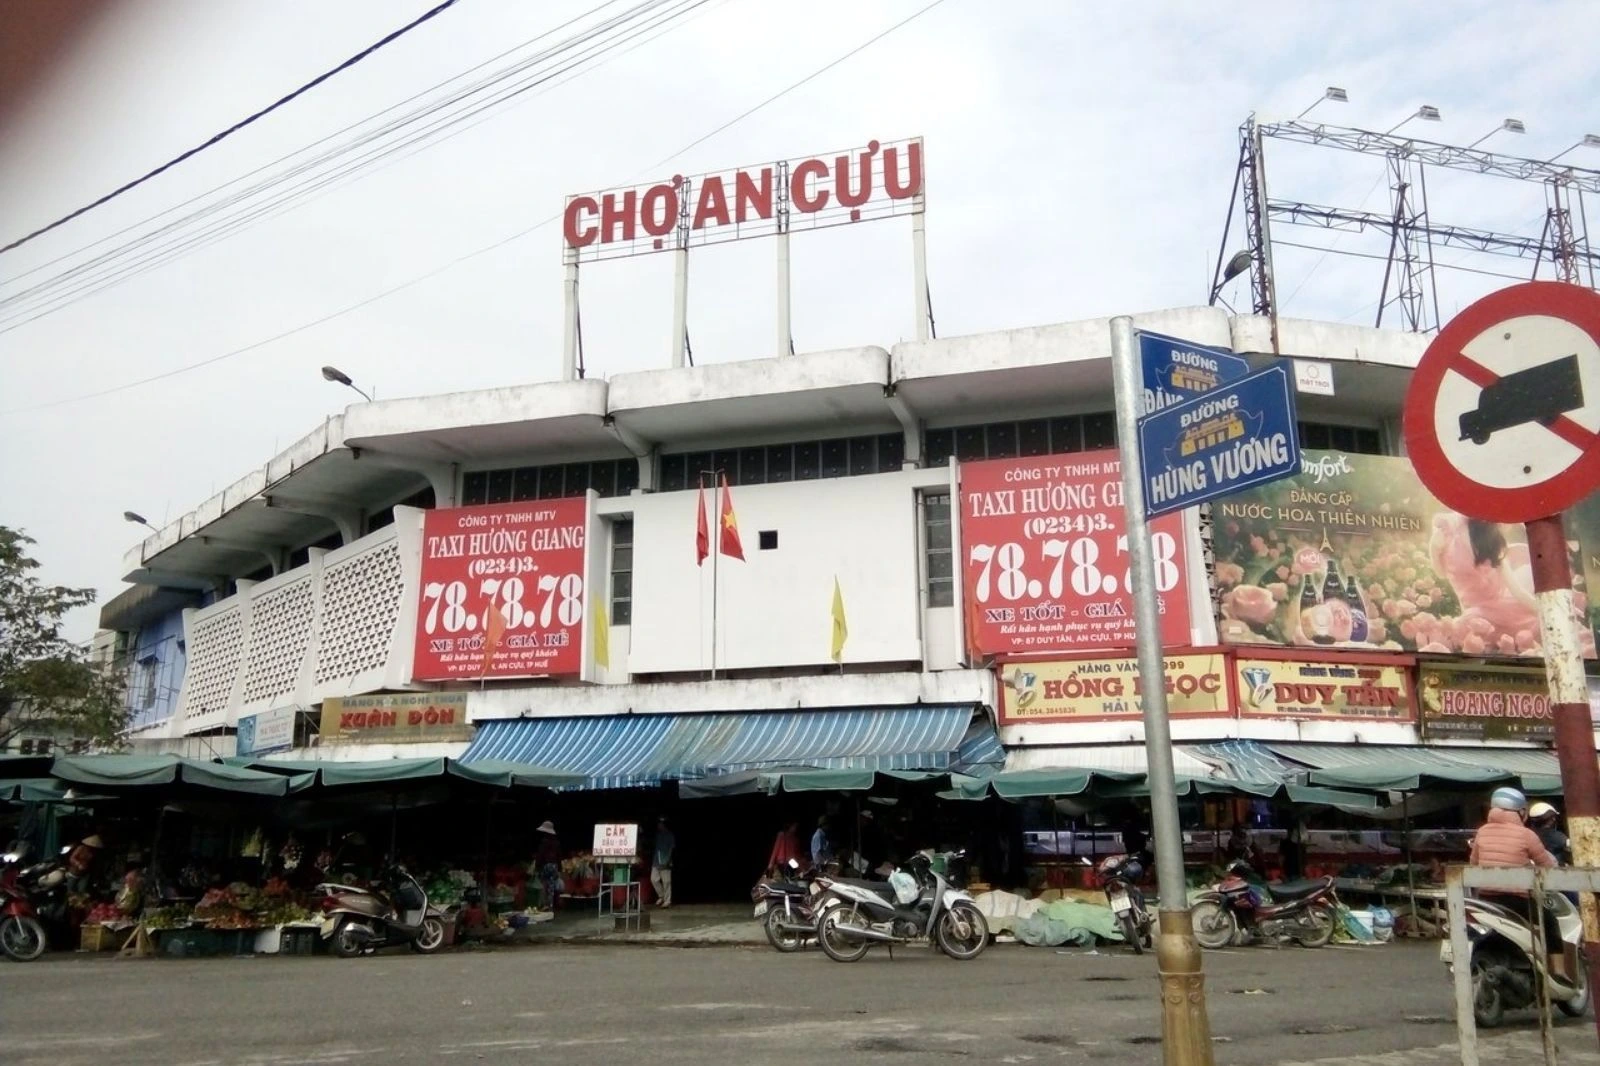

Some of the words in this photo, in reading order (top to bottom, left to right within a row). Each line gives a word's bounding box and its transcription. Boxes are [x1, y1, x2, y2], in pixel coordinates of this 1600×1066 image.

[563, 174, 683, 249] CHỢ
[692, 168, 773, 230] AN
[790, 140, 923, 223] CỰU
[1171, 350, 1218, 372] ĐƯỜNG
[1180, 394, 1239, 427] ĐƯỜNG
[1004, 467, 1041, 482] CÔNG
[1045, 467, 1061, 478] TY
[1066, 464, 1099, 477] TNHH
[1103, 461, 1121, 473] MT
[1151, 460, 1207, 504] HÙNG
[1210, 432, 1288, 483] VƯƠNG
[969, 490, 1016, 517] TAXI
[1021, 481, 1097, 513] HƯƠNG
[458, 514, 487, 528] CÔNG
[490, 514, 503, 525] TY
[505, 512, 532, 524] TNHH
[535, 510, 556, 522] MTV
[1024, 513, 1115, 539] (0234)3.
[1222, 503, 1273, 519] NƯỚC
[1278, 508, 1315, 523] HOA
[1318, 509, 1366, 526] THIÊN
[1371, 514, 1420, 530] NHIÊN
[428, 535, 465, 558] TAXI
[469, 528, 527, 555] HƯƠNG
[531, 526, 584, 551] GIANG
[468, 556, 539, 579] (0234)3.
[986, 608, 1015, 623] XE
[1020, 600, 1065, 621] TỐT
[1084, 598, 1126, 617] GIÁ
[430, 639, 454, 652] XE
[459, 632, 486, 650] TỐ
[506, 632, 539, 648] GIÁ
[1037, 634, 1054, 644] DUY
[1076, 631, 1089, 642] AN
[1124, 629, 1136, 639] HU
[1077, 663, 1111, 674] HÀNG
[1116, 661, 1142, 672] VÀN
[1043, 671, 1124, 699] HỒNG
[1273, 683, 1337, 705] DUY
